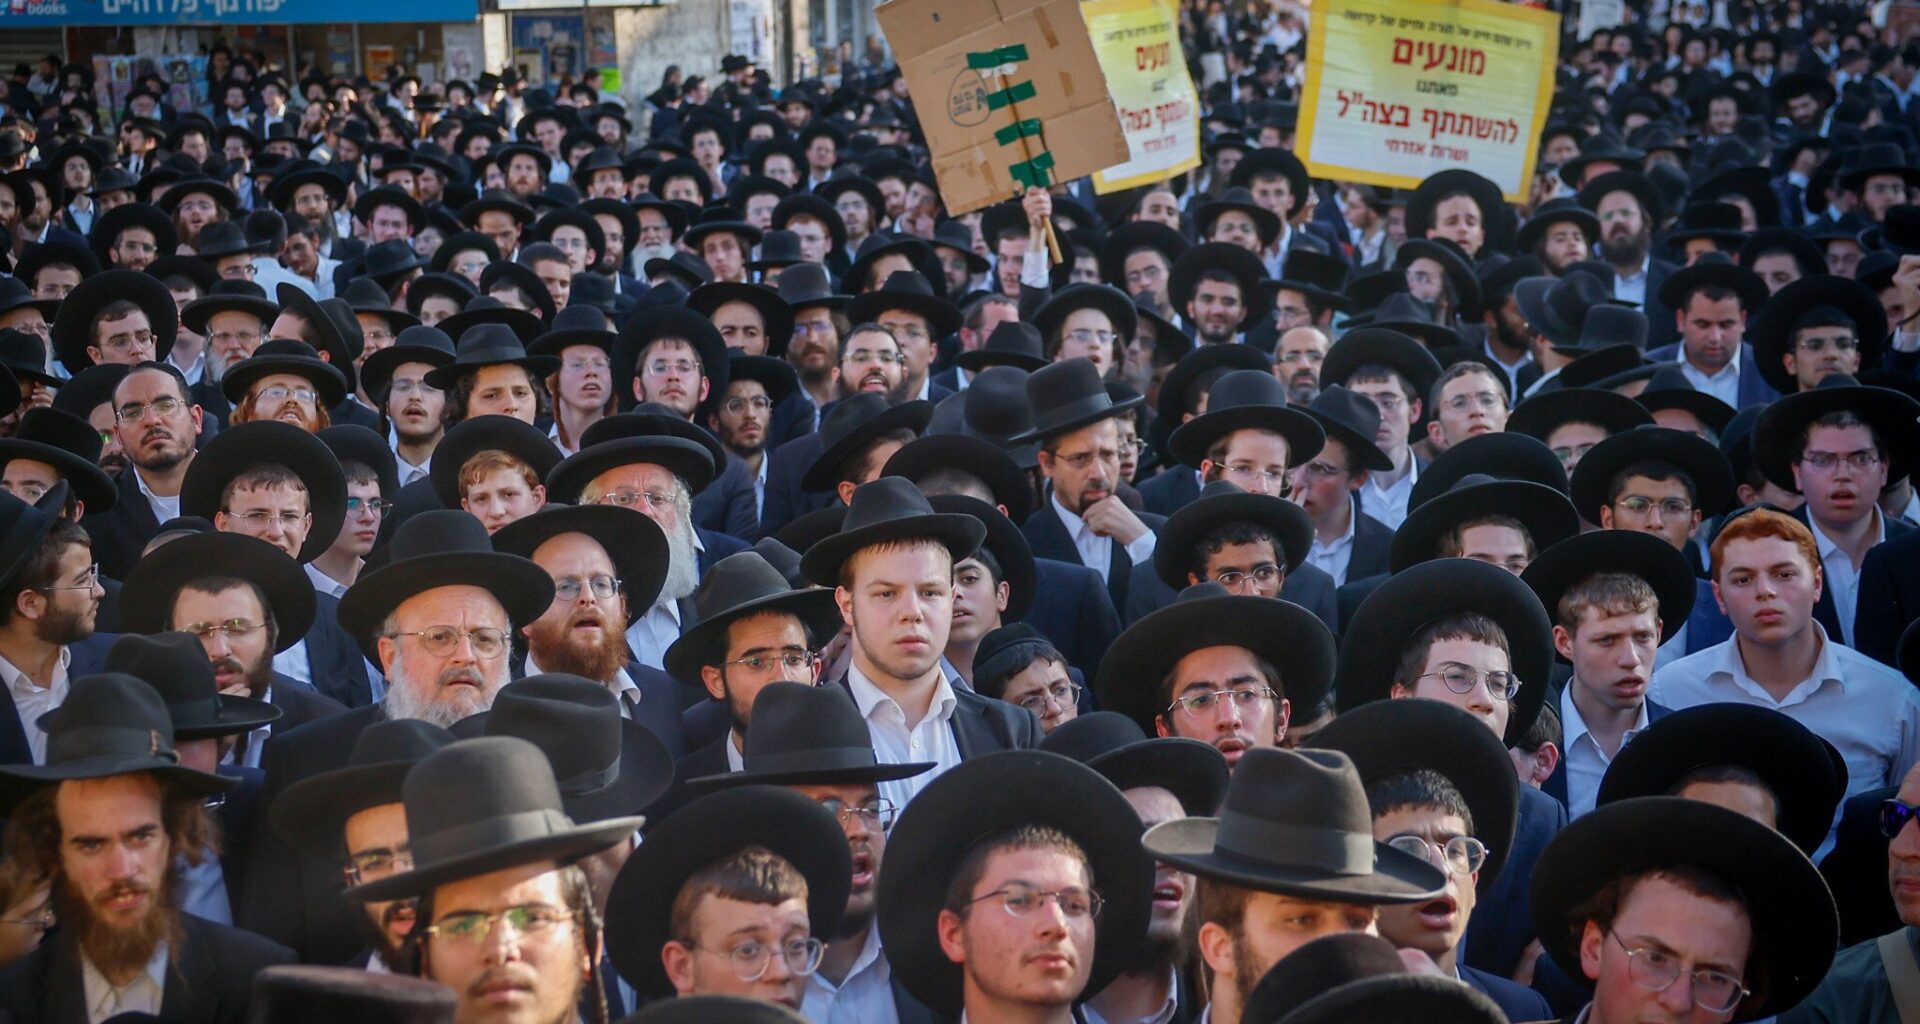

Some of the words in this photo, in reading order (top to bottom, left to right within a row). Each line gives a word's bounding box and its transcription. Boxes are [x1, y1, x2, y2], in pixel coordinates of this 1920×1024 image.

[246, 0, 286, 12] פה
[1380, 13, 1396, 27] של
[1392, 37, 1486, 77] מונעים
[1416, 80, 1459, 97] מאתנו
[1422, 108, 1518, 145] להשתתף
[1385, 139, 1426, 156] אזרחי
